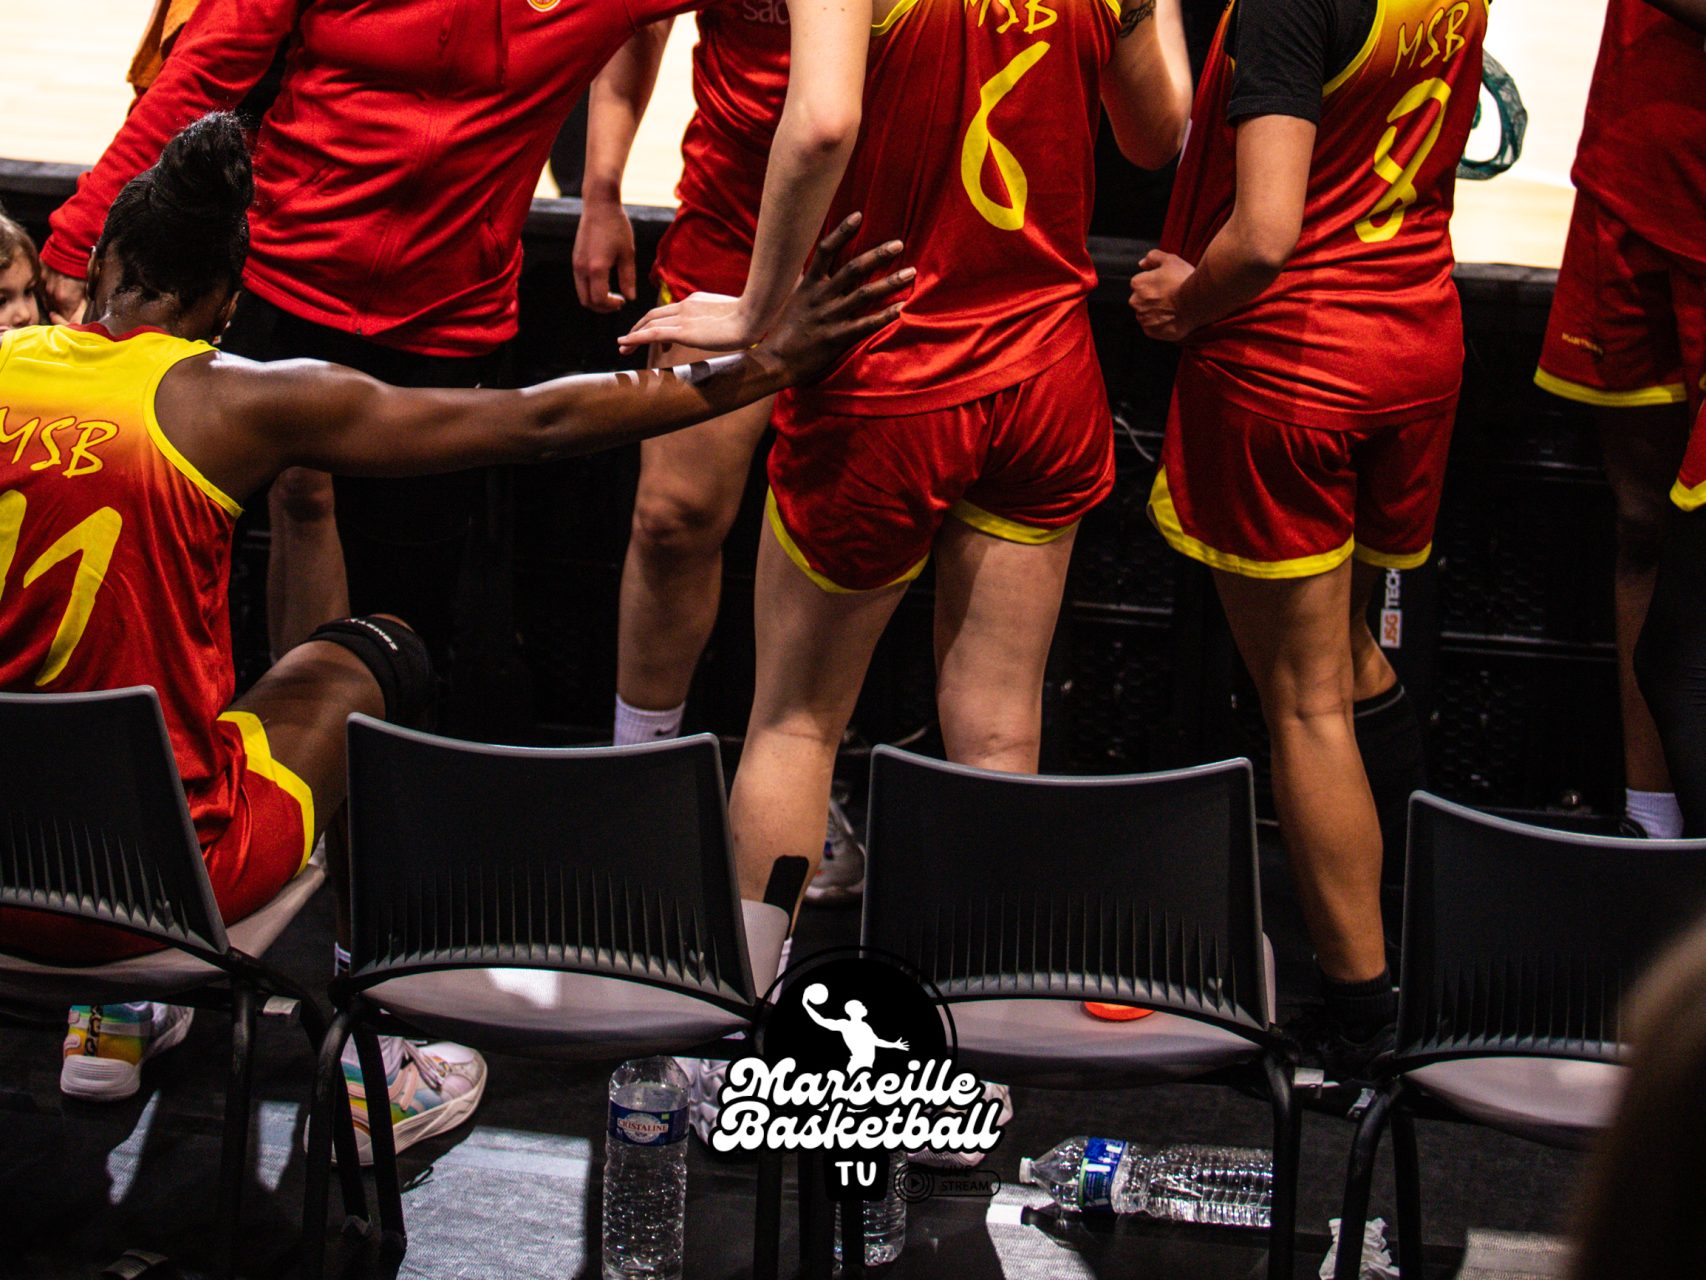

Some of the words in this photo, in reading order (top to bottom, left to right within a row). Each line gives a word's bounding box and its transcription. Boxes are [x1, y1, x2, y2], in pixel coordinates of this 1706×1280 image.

[1391, 1, 1470, 78] MSB
[961, 40, 1051, 232] 6
[1354, 77, 1452, 244] 8
[0, 406, 119, 478] MSB
[1384, 613, 1399, 646] JSG
[618, 1119, 667, 1133] CRISTALINE
